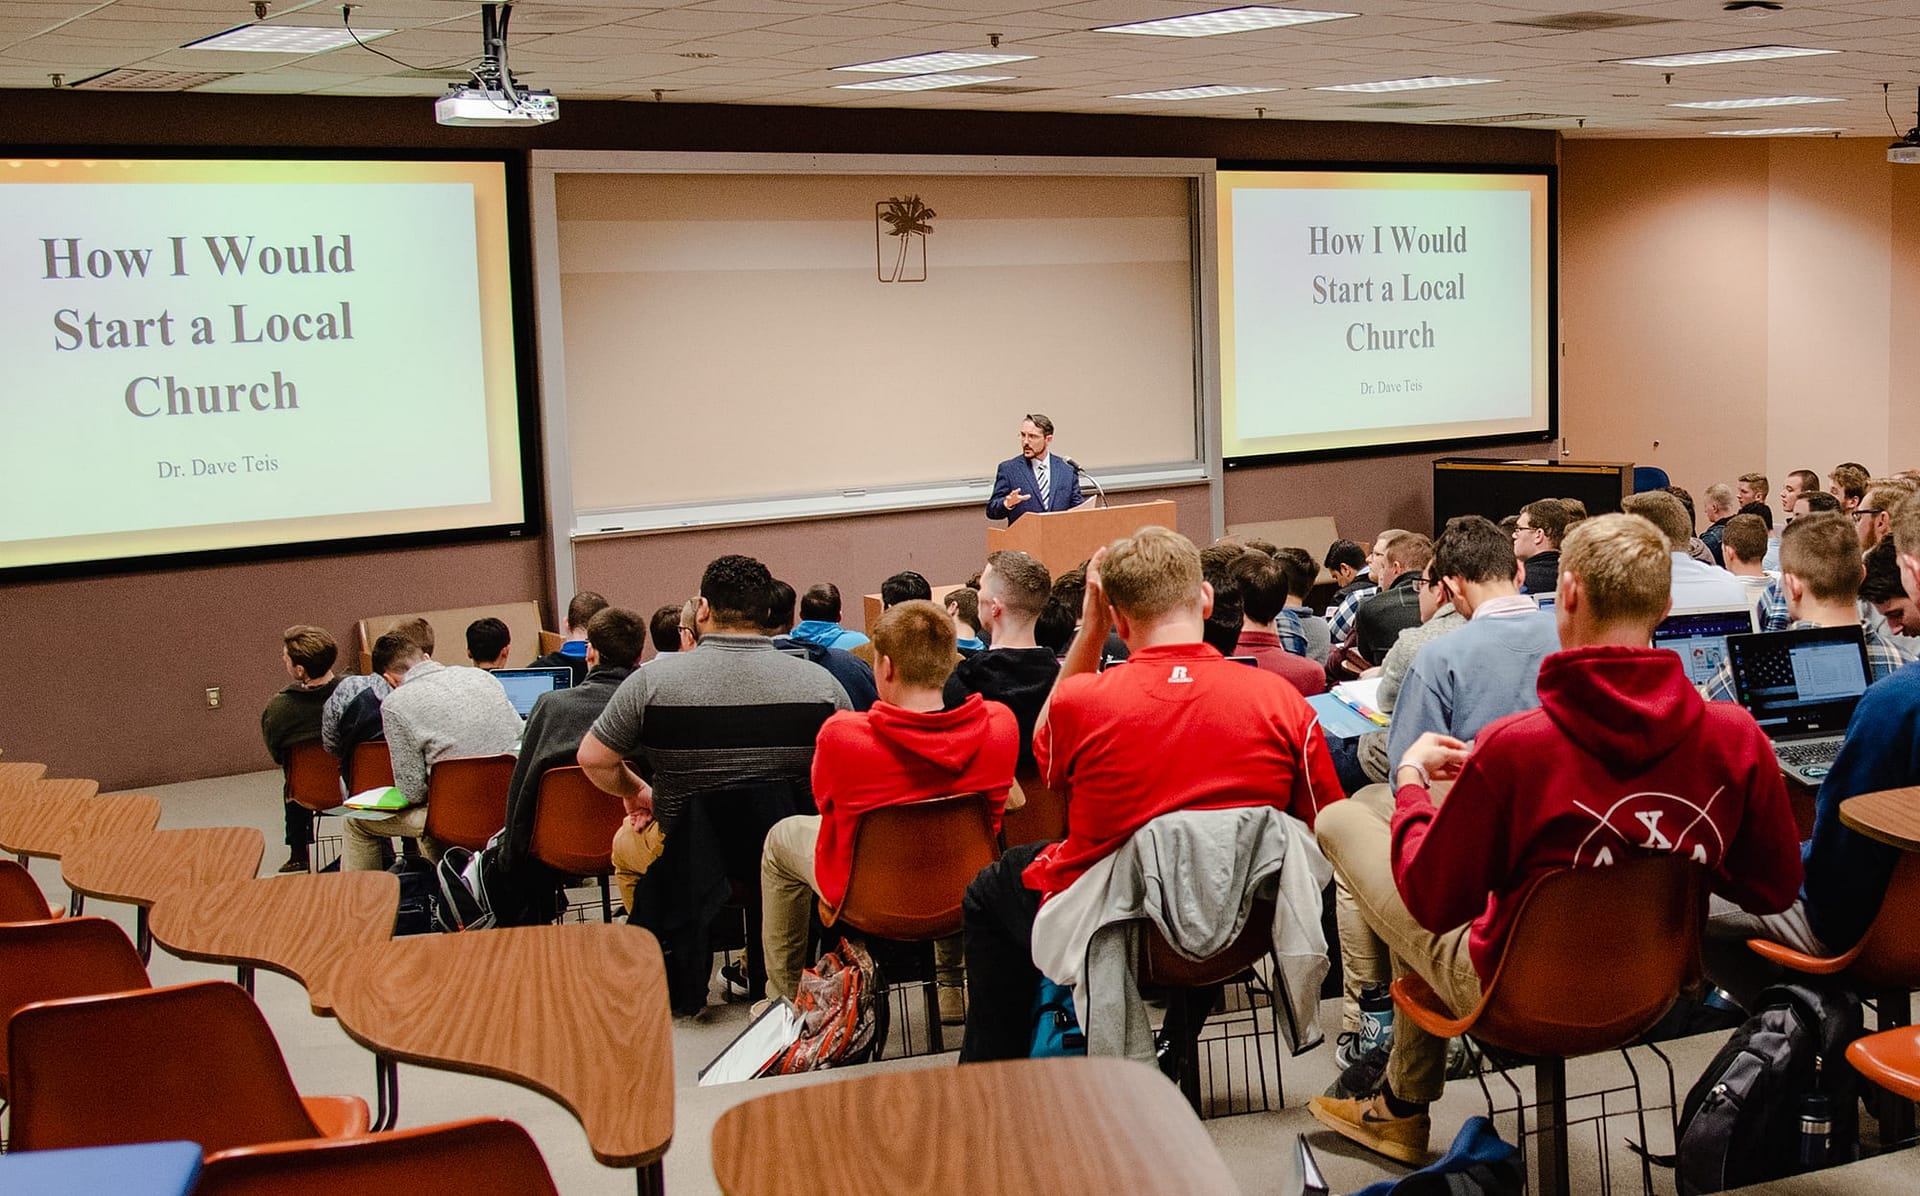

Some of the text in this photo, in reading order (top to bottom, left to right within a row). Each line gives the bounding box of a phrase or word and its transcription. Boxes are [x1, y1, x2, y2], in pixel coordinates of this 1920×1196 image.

[1308, 226, 1467, 255] How I Would
[40, 235, 355, 279] How I Would
[1312, 273, 1465, 304] Start a Local
[54, 302, 354, 350] Start a Local
[1346, 321, 1435, 352] Church
[125, 371, 300, 417] Church
[1360, 378, 1423, 395] Dr. Dave Teis
[157, 453, 279, 479] Dr. Dave Teis
[1635, 811, 1672, 849] X
